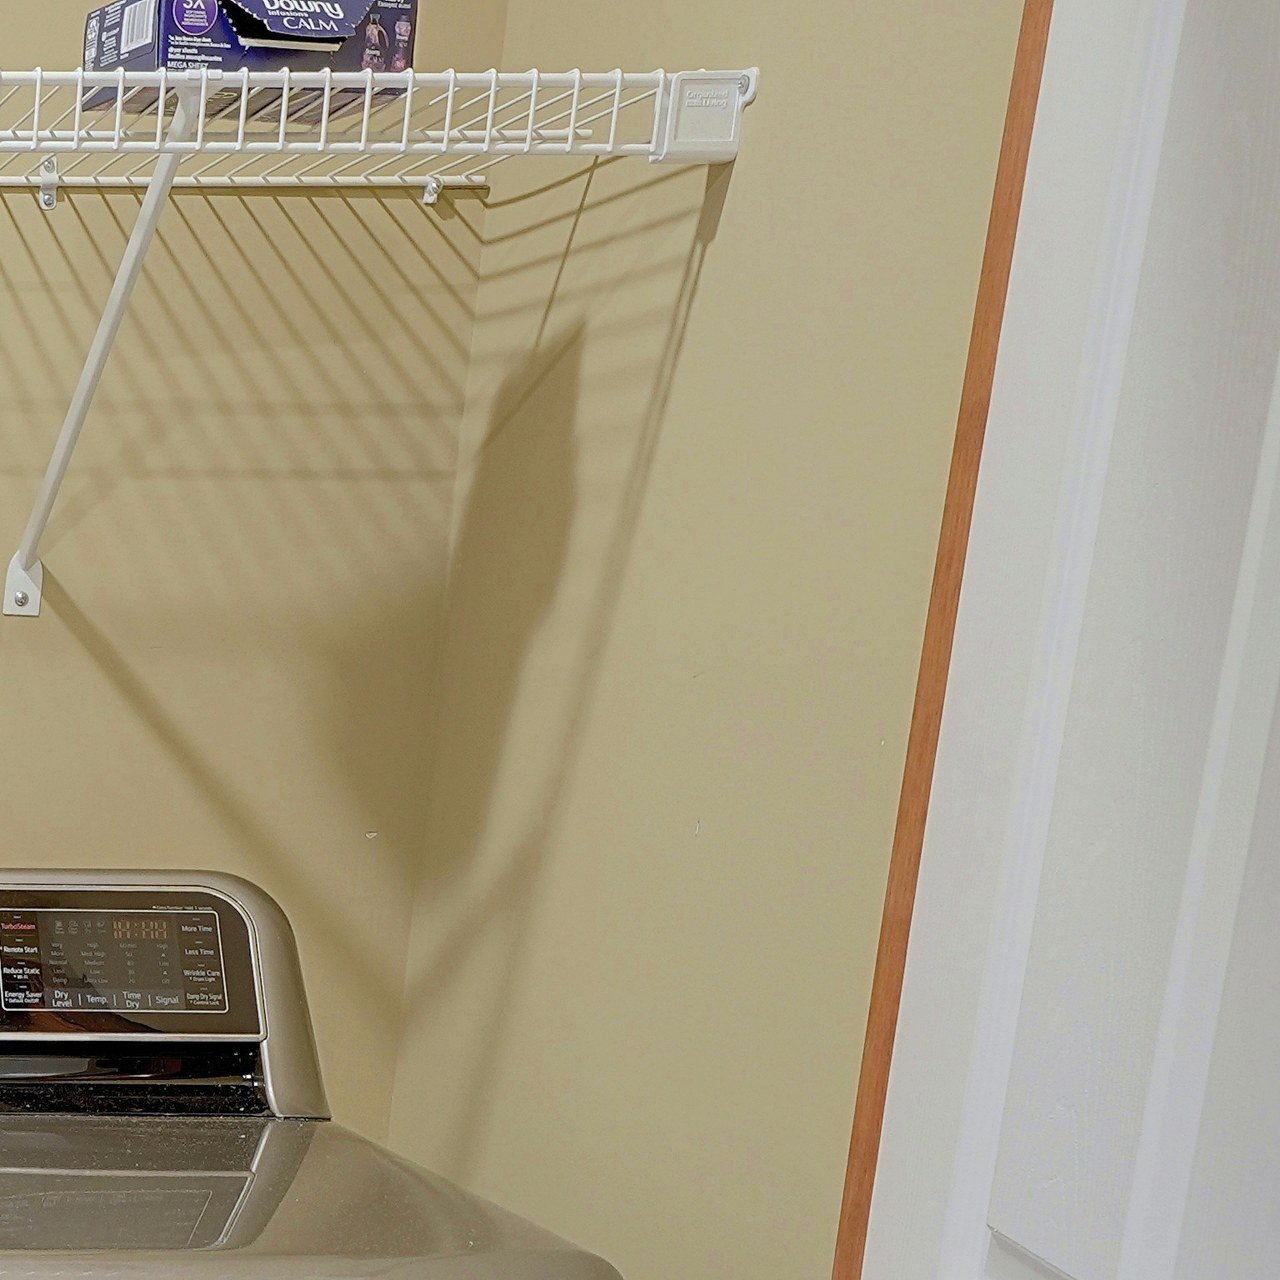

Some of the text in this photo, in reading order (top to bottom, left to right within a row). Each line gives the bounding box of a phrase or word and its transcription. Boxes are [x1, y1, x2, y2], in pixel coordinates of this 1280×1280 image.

[283, 17, 339, 31] CALM
[198, 925, 213, 933] Time
[24, 946, 38, 954] Start
[24, 967, 41, 975] Static
[4, 990, 43, 1000] Energy Saver
[54, 990, 69, 1000] Dry
[86, 994, 109, 1005] Temp.
[122, 991, 142, 1000] Time
[52, 999, 73, 1008] Level
[125, 1000, 140, 1009] Dry
[155, 996, 179, 1006] Signal
